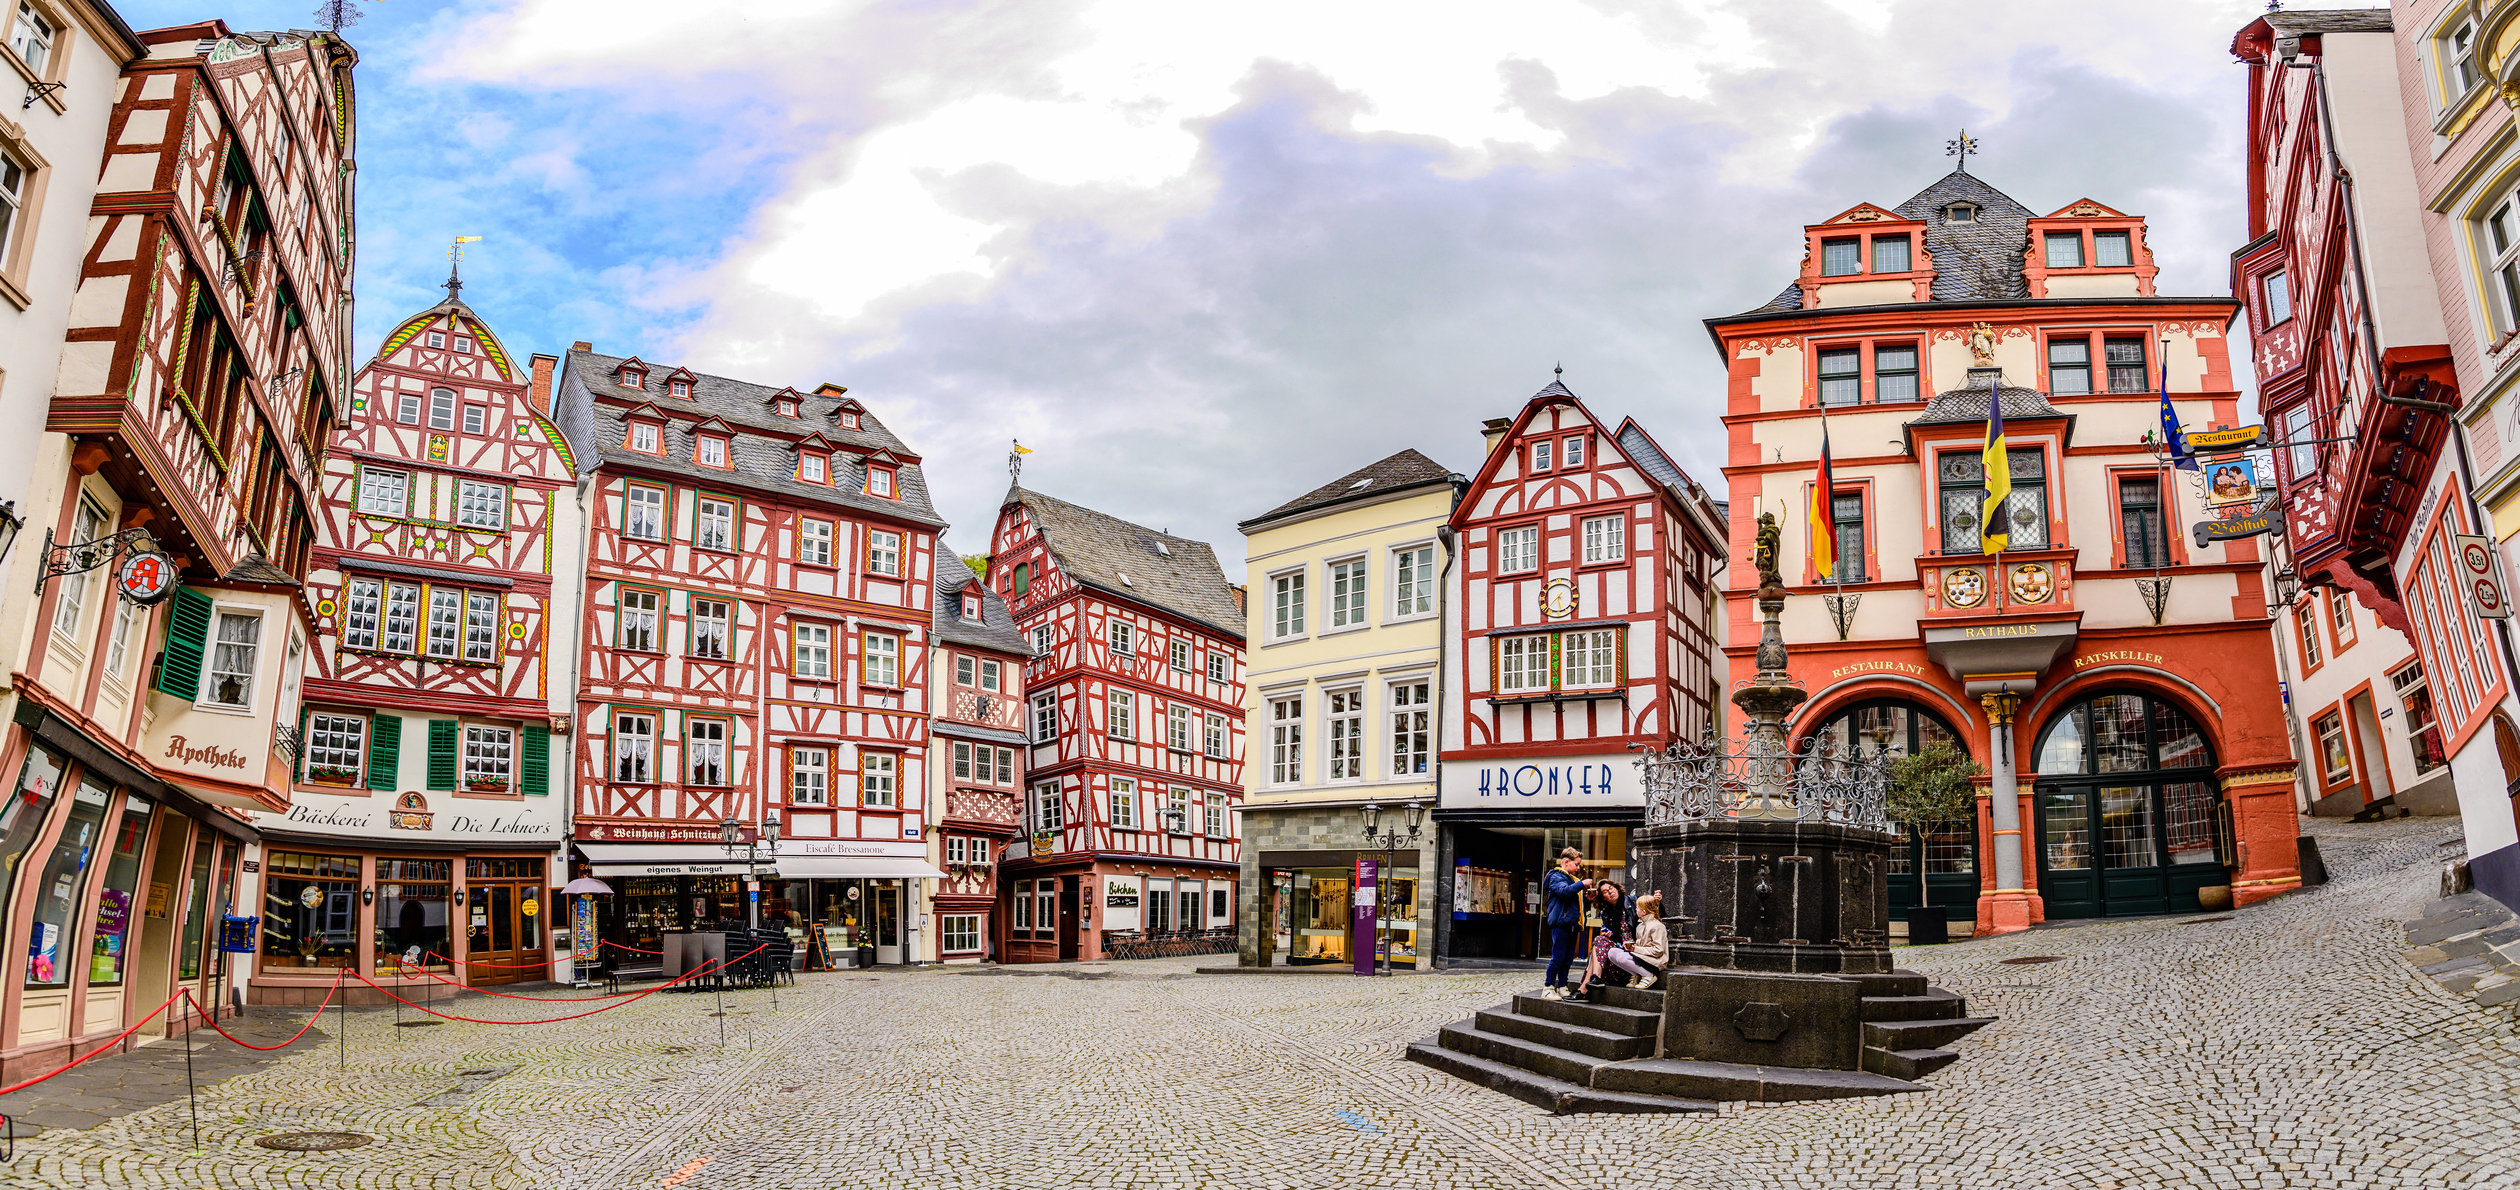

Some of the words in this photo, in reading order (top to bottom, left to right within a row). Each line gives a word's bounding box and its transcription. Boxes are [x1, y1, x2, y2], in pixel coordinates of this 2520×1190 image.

[2195, 430, 2252, 446] Restaurant
[1965, 624, 2038, 638] RATHAUS
[2073, 650, 2163, 668] RATSKELLER
[1831, 660, 1925, 679] RESTAURANT
[165, 735, 247, 769] Apotheke
[1478, 763, 1612, 797] KRONSER
[287, 803, 371, 828] Bäckerei
[451, 815, 483, 833] Die
[488, 809, 551, 834] Lohner's
[613, 827, 666, 840] Weinhaus
[670, 828, 723, 841] Schnitzius
[805, 843, 835, 853] Eiscafé
[838, 844, 885, 854] Bressanone
[100, 899, 118, 908] allo
[97, 914, 115, 926] hre.
[98, 907, 124, 918] hsel-
